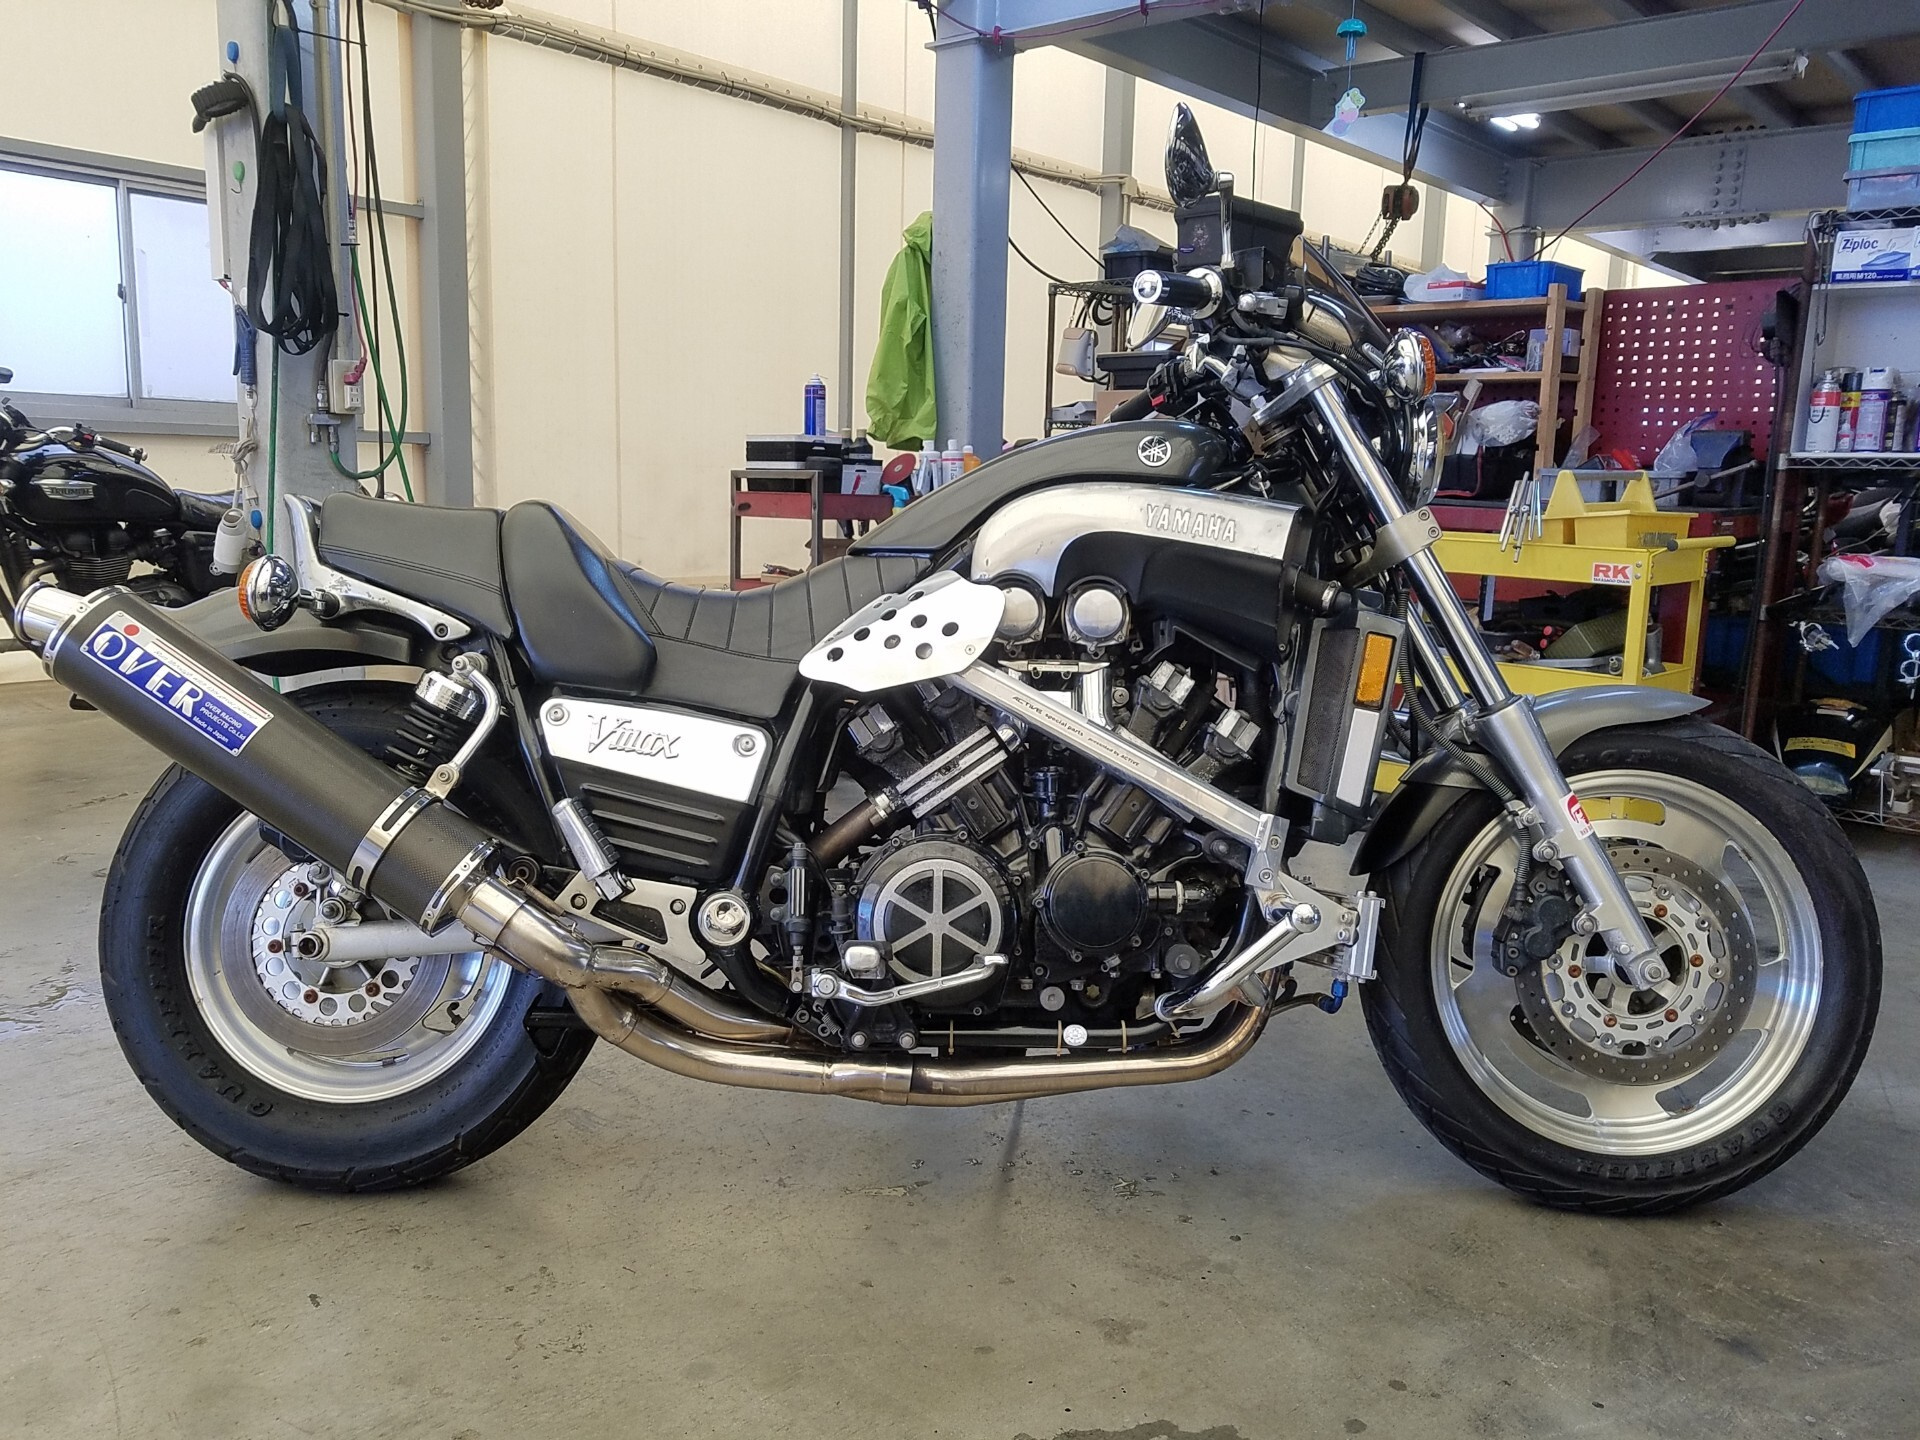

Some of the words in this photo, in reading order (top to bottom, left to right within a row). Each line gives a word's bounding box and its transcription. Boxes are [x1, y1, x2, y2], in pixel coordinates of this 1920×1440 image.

[1842, 237, 1879, 253] Ziploc
[1146, 503, 1236, 543] YAMAHA
[1593, 563, 1631, 580] RK
[93, 631, 204, 718] OVER
[192, 715, 208, 729] Made
[212, 729, 229, 743] Japan
[199, 706, 230, 729] PROJECTS
[204, 701, 222, 715] OVER
[219, 711, 243, 729] RACING
[1012, 696, 1043, 715] ACTIVE
[1045, 712, 1067, 728] special
[1067, 724, 1084, 737] parts
